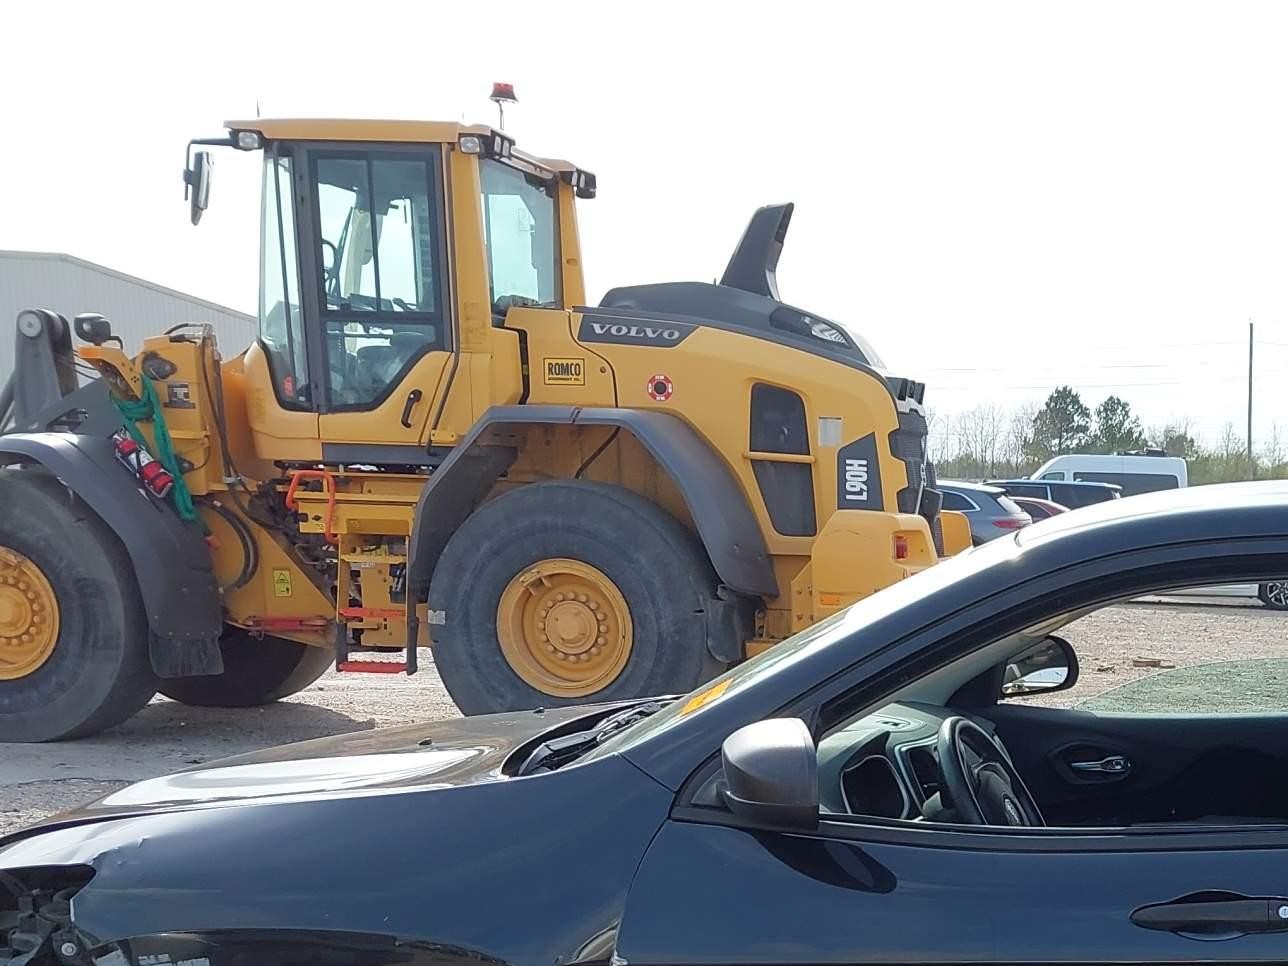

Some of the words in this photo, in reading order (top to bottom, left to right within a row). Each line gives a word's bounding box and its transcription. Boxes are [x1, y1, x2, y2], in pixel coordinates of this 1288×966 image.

[590, 322, 680, 340] VOLVO
[547, 362, 581, 377] ROMCO
[845, 459, 868, 501] L90H
